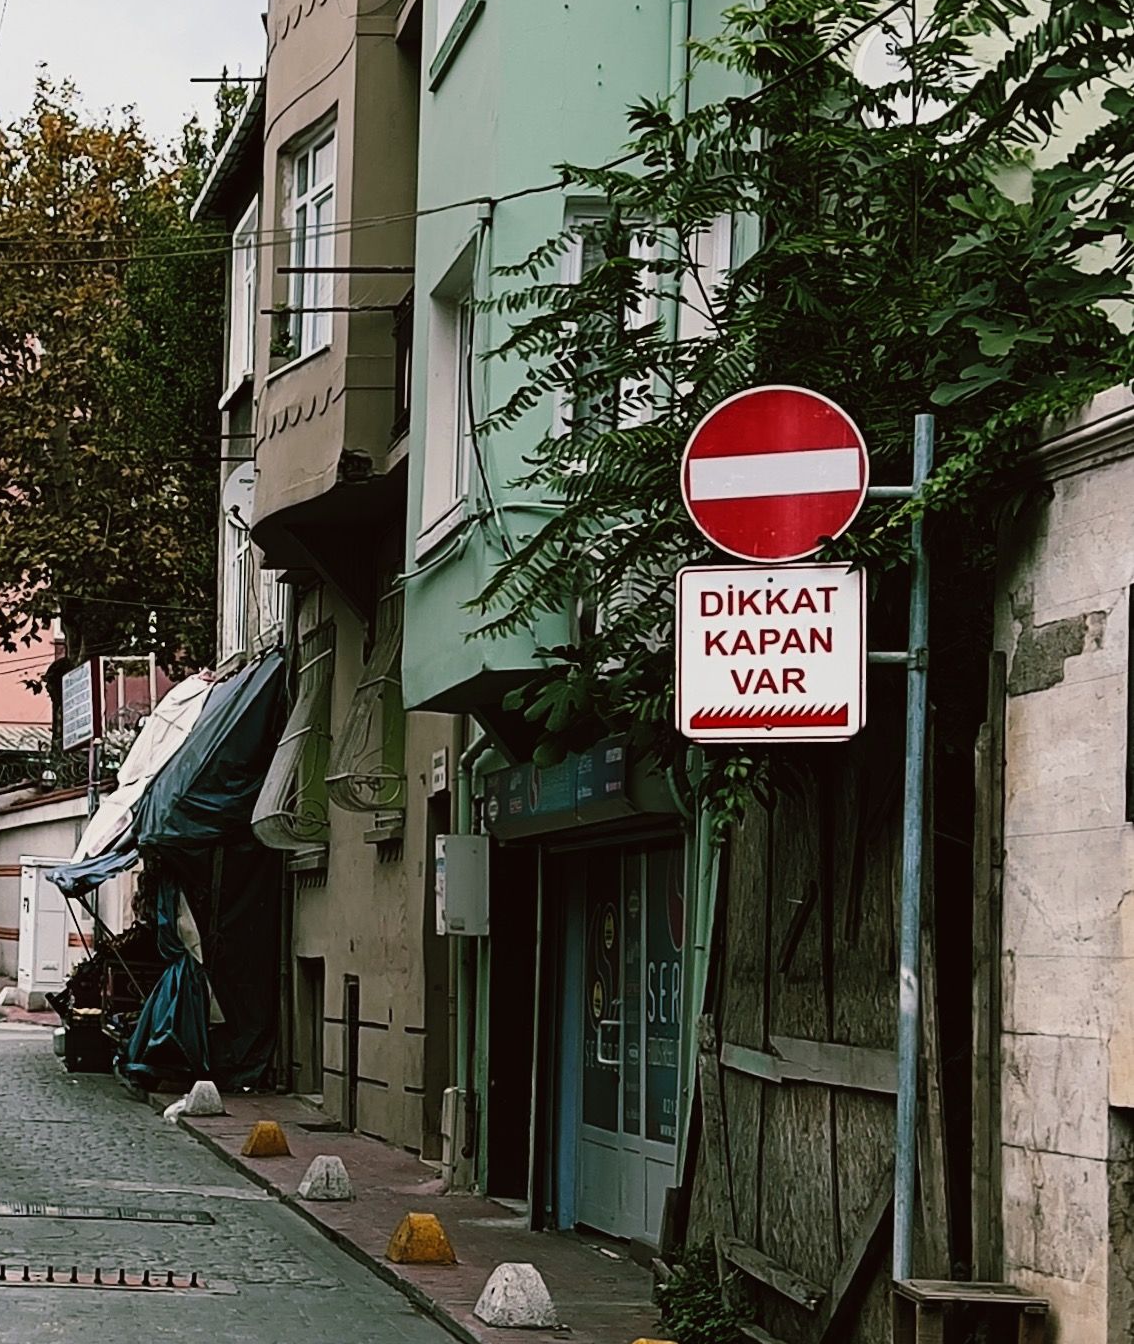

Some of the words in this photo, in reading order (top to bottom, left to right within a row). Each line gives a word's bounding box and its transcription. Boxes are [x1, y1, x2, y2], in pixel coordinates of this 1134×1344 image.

[700, 584, 838, 617] DİKKAT
[705, 627, 833, 657] KAPAN
[730, 667, 806, 695] VAR
